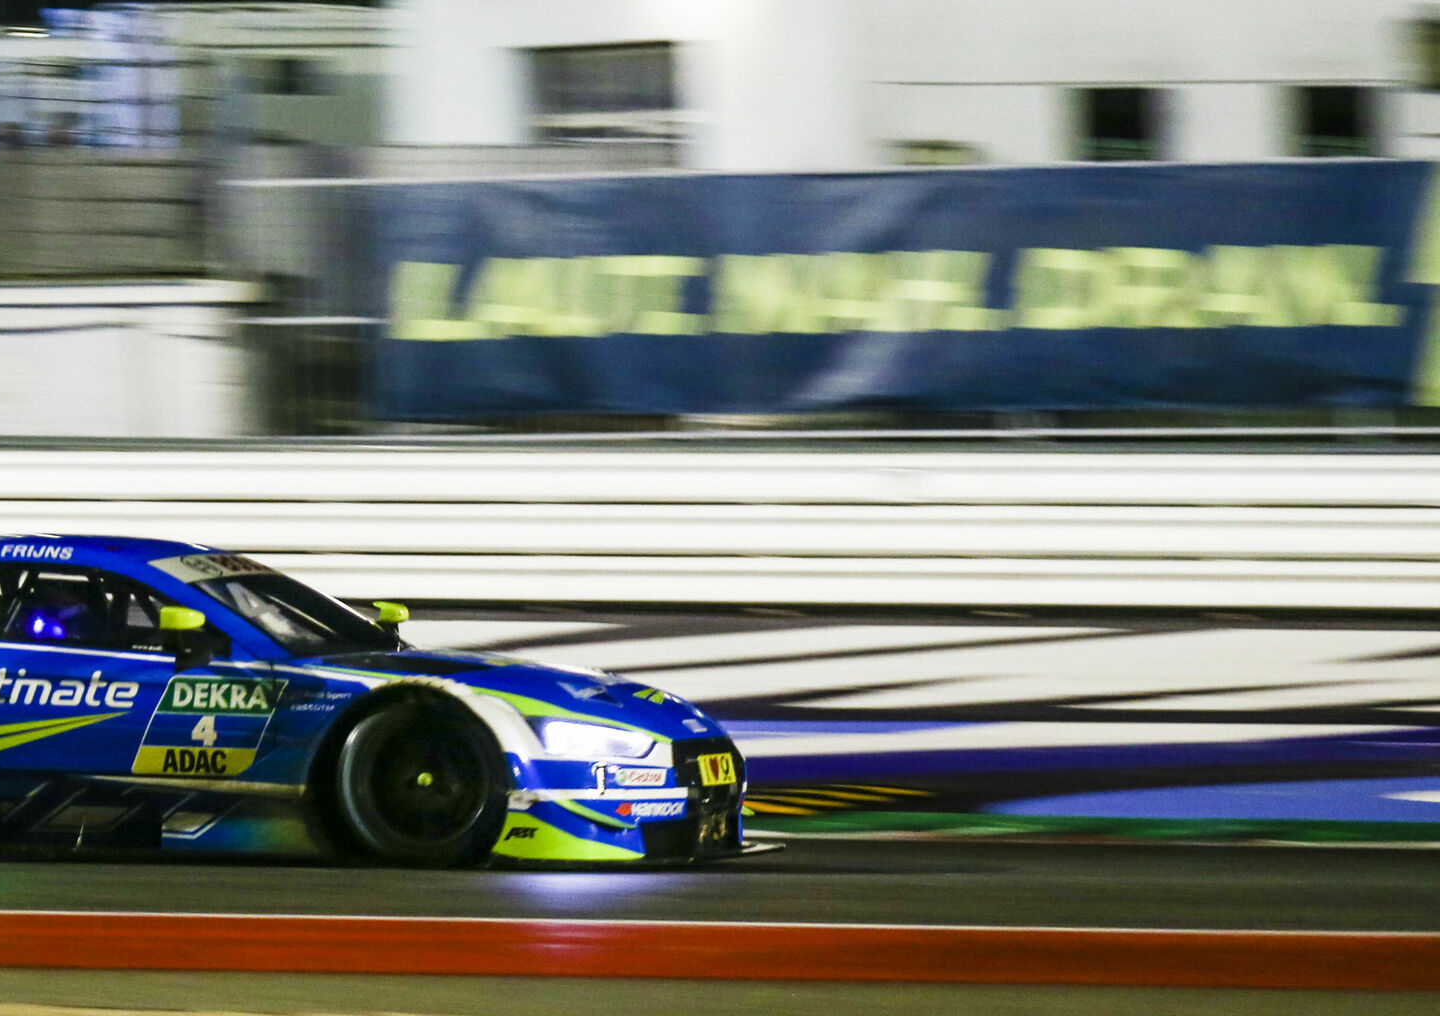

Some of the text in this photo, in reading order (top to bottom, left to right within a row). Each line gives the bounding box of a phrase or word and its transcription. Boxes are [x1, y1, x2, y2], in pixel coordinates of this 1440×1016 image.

[0, 544, 74, 560] FRIJNS
[172, 682, 268, 710] DEKRA
[191, 715, 217, 747] 4
[162, 749, 227, 774] ADAC
[503, 827, 539, 841] ABT
